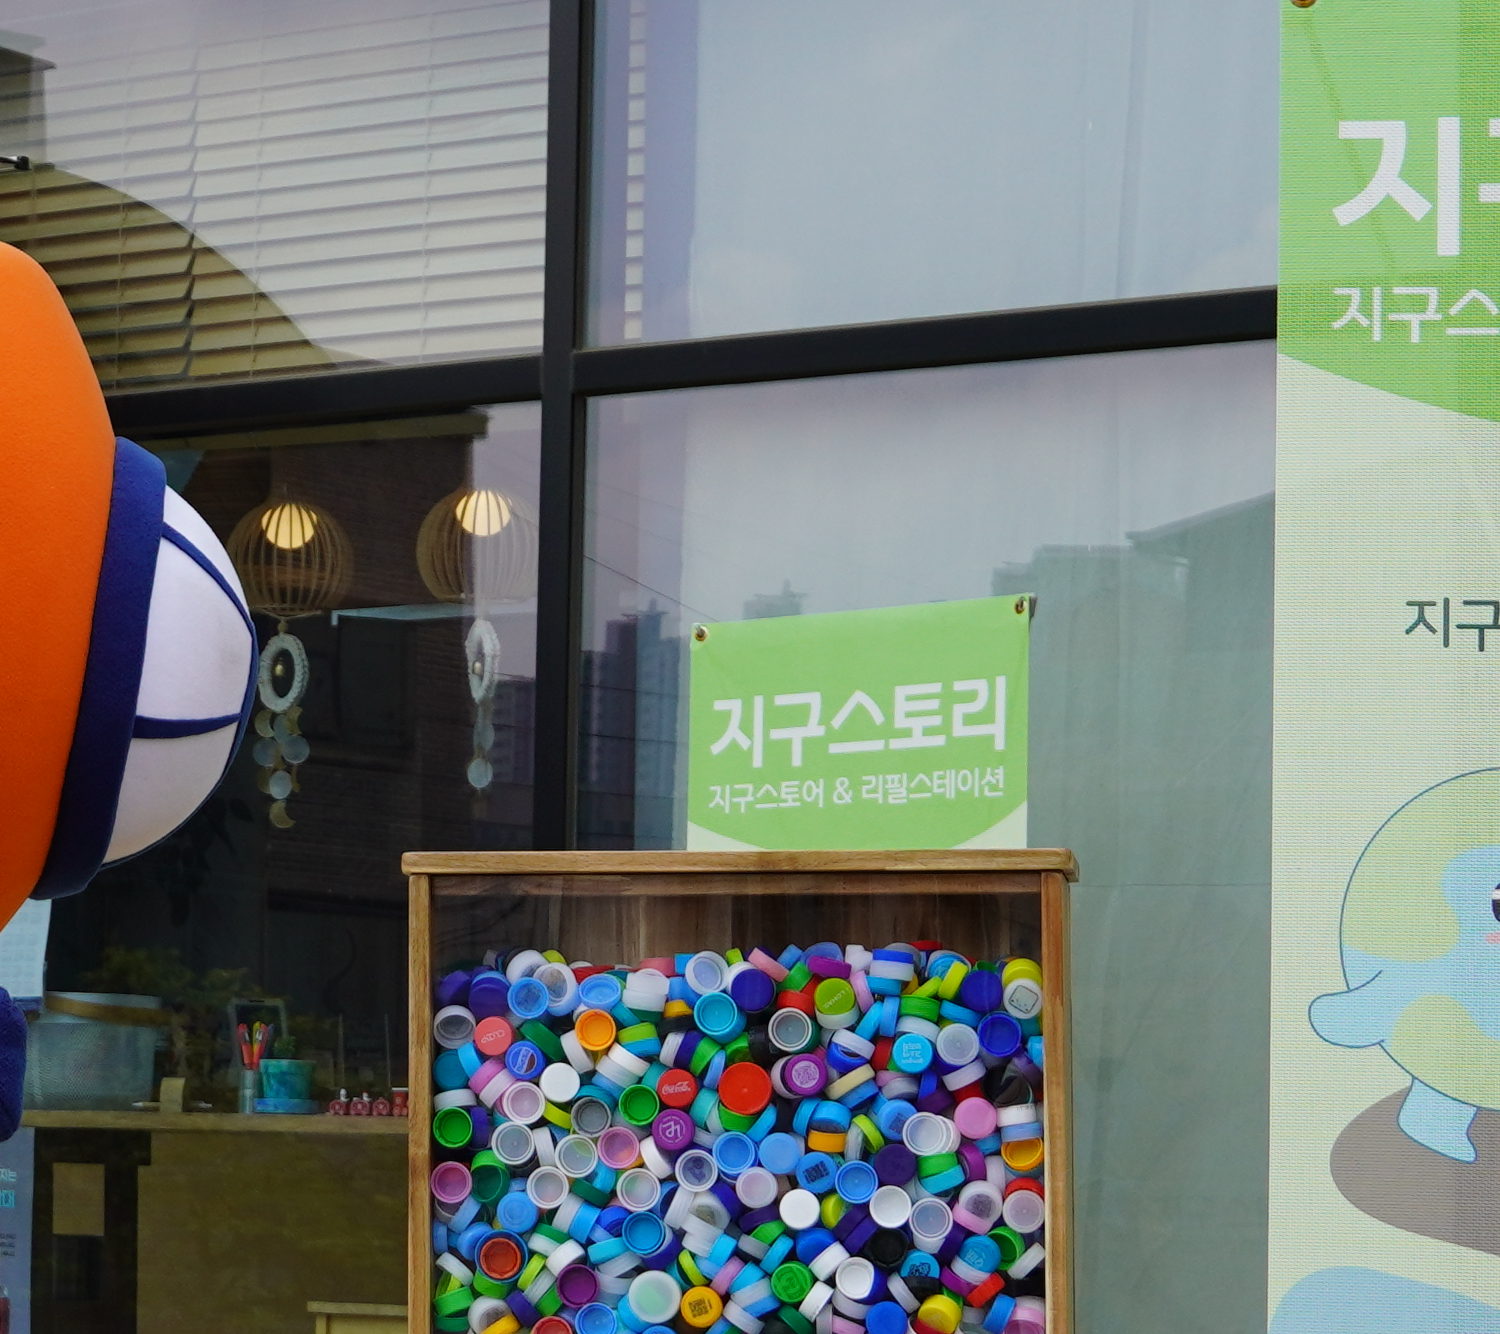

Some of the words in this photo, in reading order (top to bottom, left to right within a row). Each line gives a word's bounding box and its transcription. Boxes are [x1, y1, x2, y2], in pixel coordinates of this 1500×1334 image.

[710, 675, 1006, 768] 지구스토리
[708, 779, 824, 813] 지구스토어
[833, 778, 852, 803] &
[862, 766, 1005, 804] 리필스테이션
